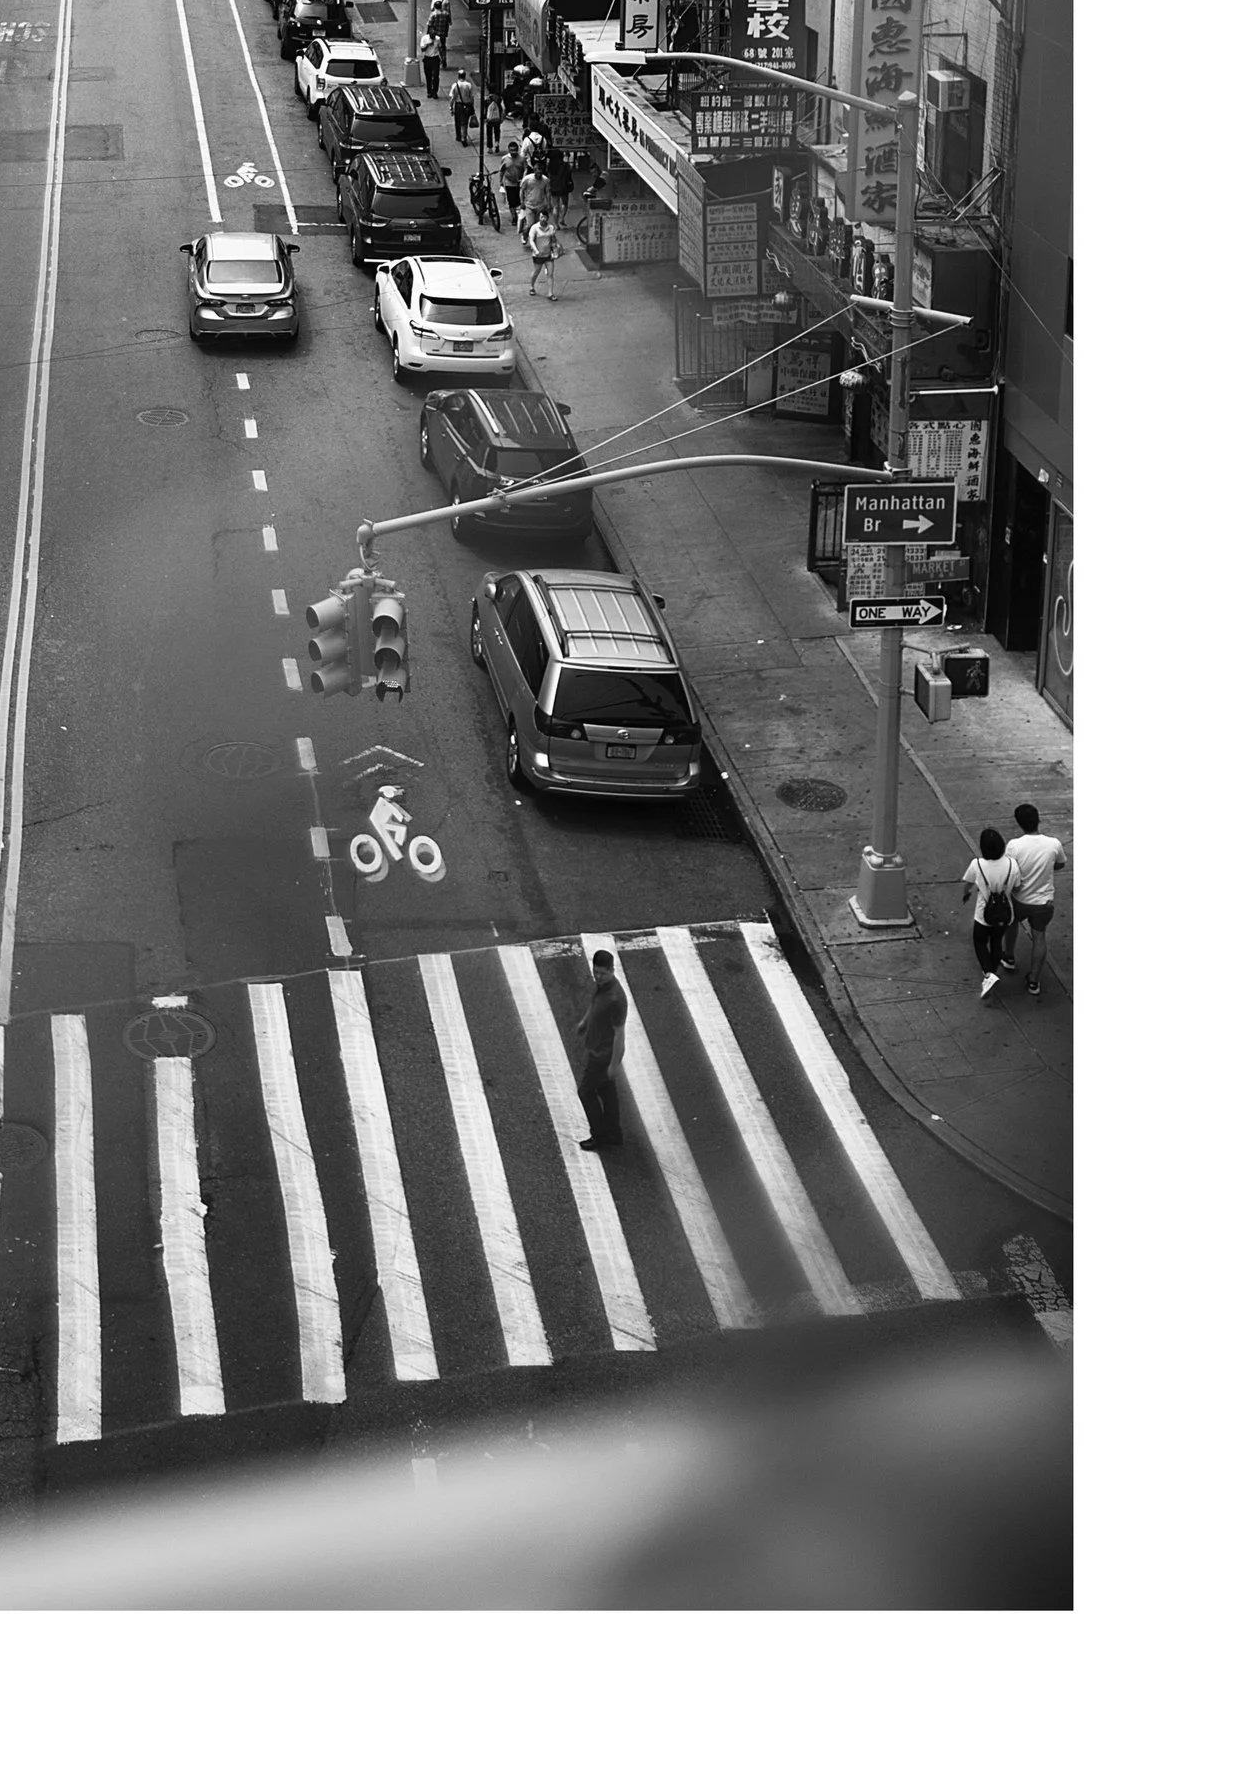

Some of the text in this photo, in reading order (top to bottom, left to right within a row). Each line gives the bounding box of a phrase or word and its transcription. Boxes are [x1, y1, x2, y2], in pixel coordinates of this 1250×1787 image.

[855, 495, 946, 511] Manhattan
[863, 517, 882, 532] Br
[912, 560, 955, 575] MARKET
[858, 606, 932, 619] ONE WAY
